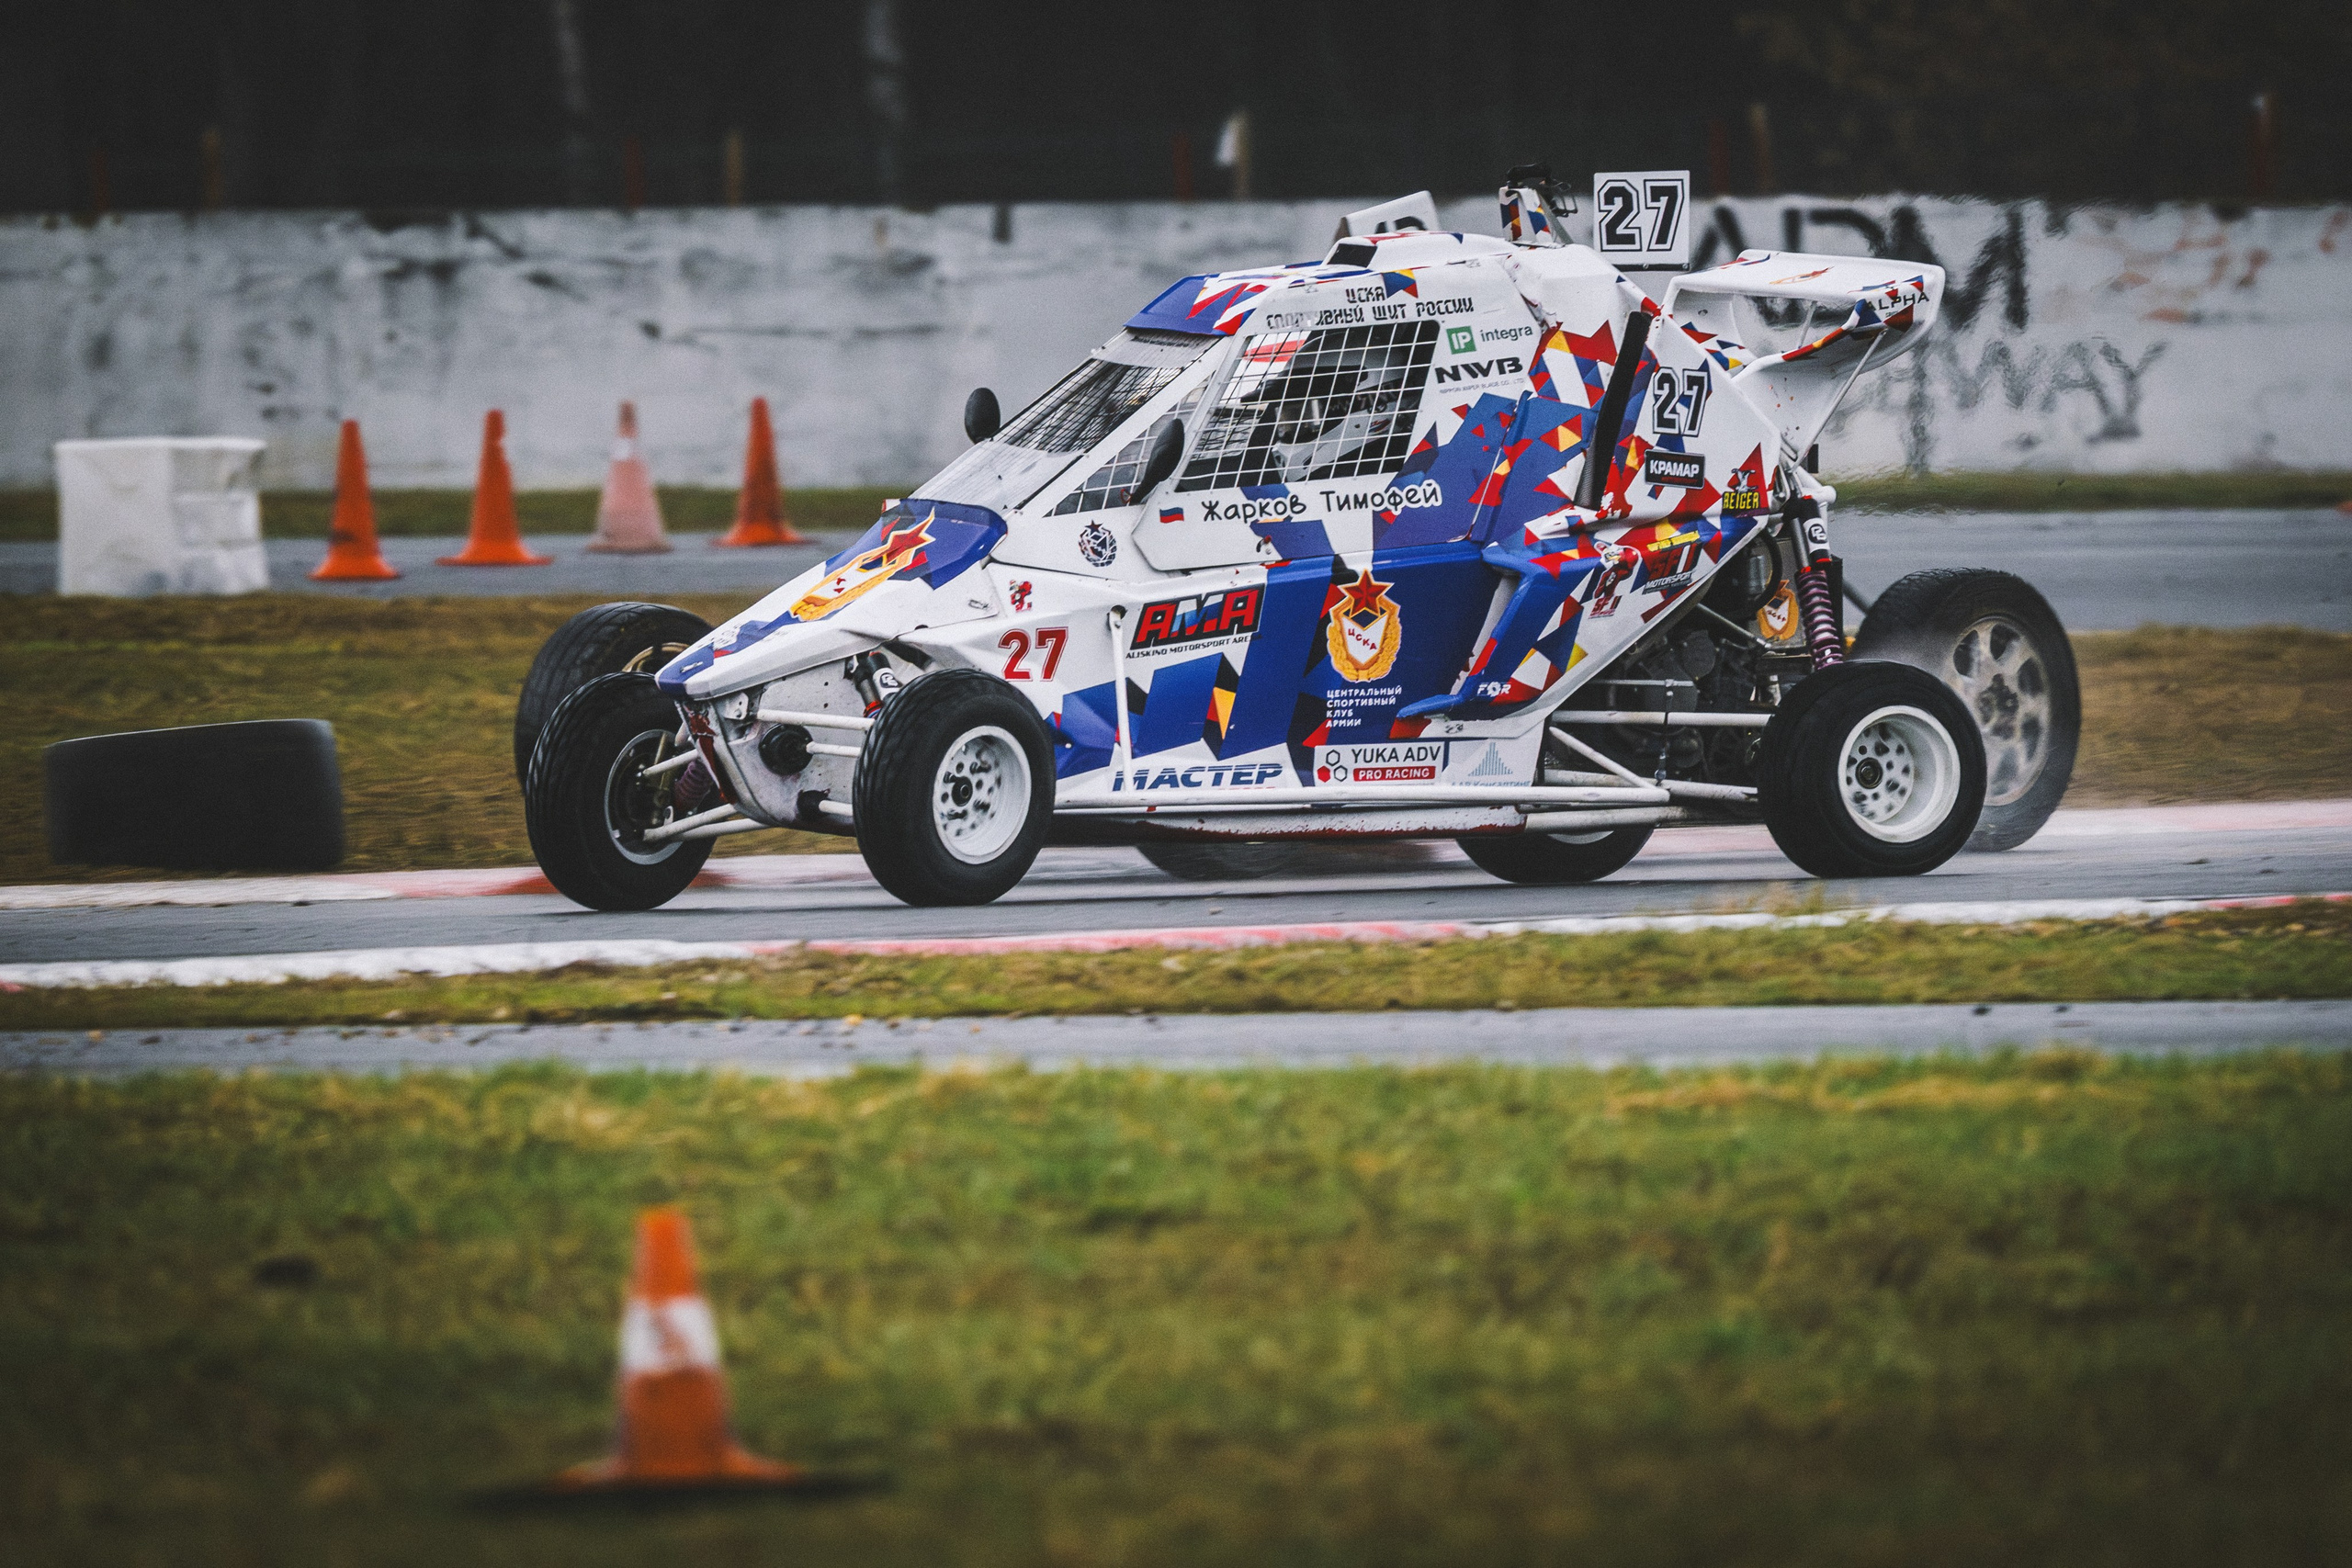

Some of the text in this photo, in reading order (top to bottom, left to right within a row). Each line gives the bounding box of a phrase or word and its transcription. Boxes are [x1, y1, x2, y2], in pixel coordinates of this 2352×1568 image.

[1598, 179, 1684, 252] 27
[1415, 297, 1474, 318] РОССИИ
[1866, 291, 1929, 310] ALPHA
[1480, 326, 1533, 342] integra
[1434, 356, 1523, 384] NWB
[1653, 367, 1708, 437] 27
[1650, 460, 1700, 478] КРАМАР
[1201, 483, 1440, 524] Жарков Тимофей
[1723, 491, 1759, 509] REIGER
[1348, 628, 1377, 650] ЦСКА
[998, 626, 1069, 682] 27
[1327, 685, 1402, 698] ЦЕНТРАЛЬНЫЙ
[1326, 696, 1396, 708] СПОРТИВНЫЙ
[1326, 708, 1353, 718] КЛУБ
[1326, 717, 1362, 728] АРМИИ
[1351, 745, 1442, 763] YUKA ADV
[1113, 762, 1283, 792] МАСТЕР
[1358, 768, 1430, 780] PRO RACING
